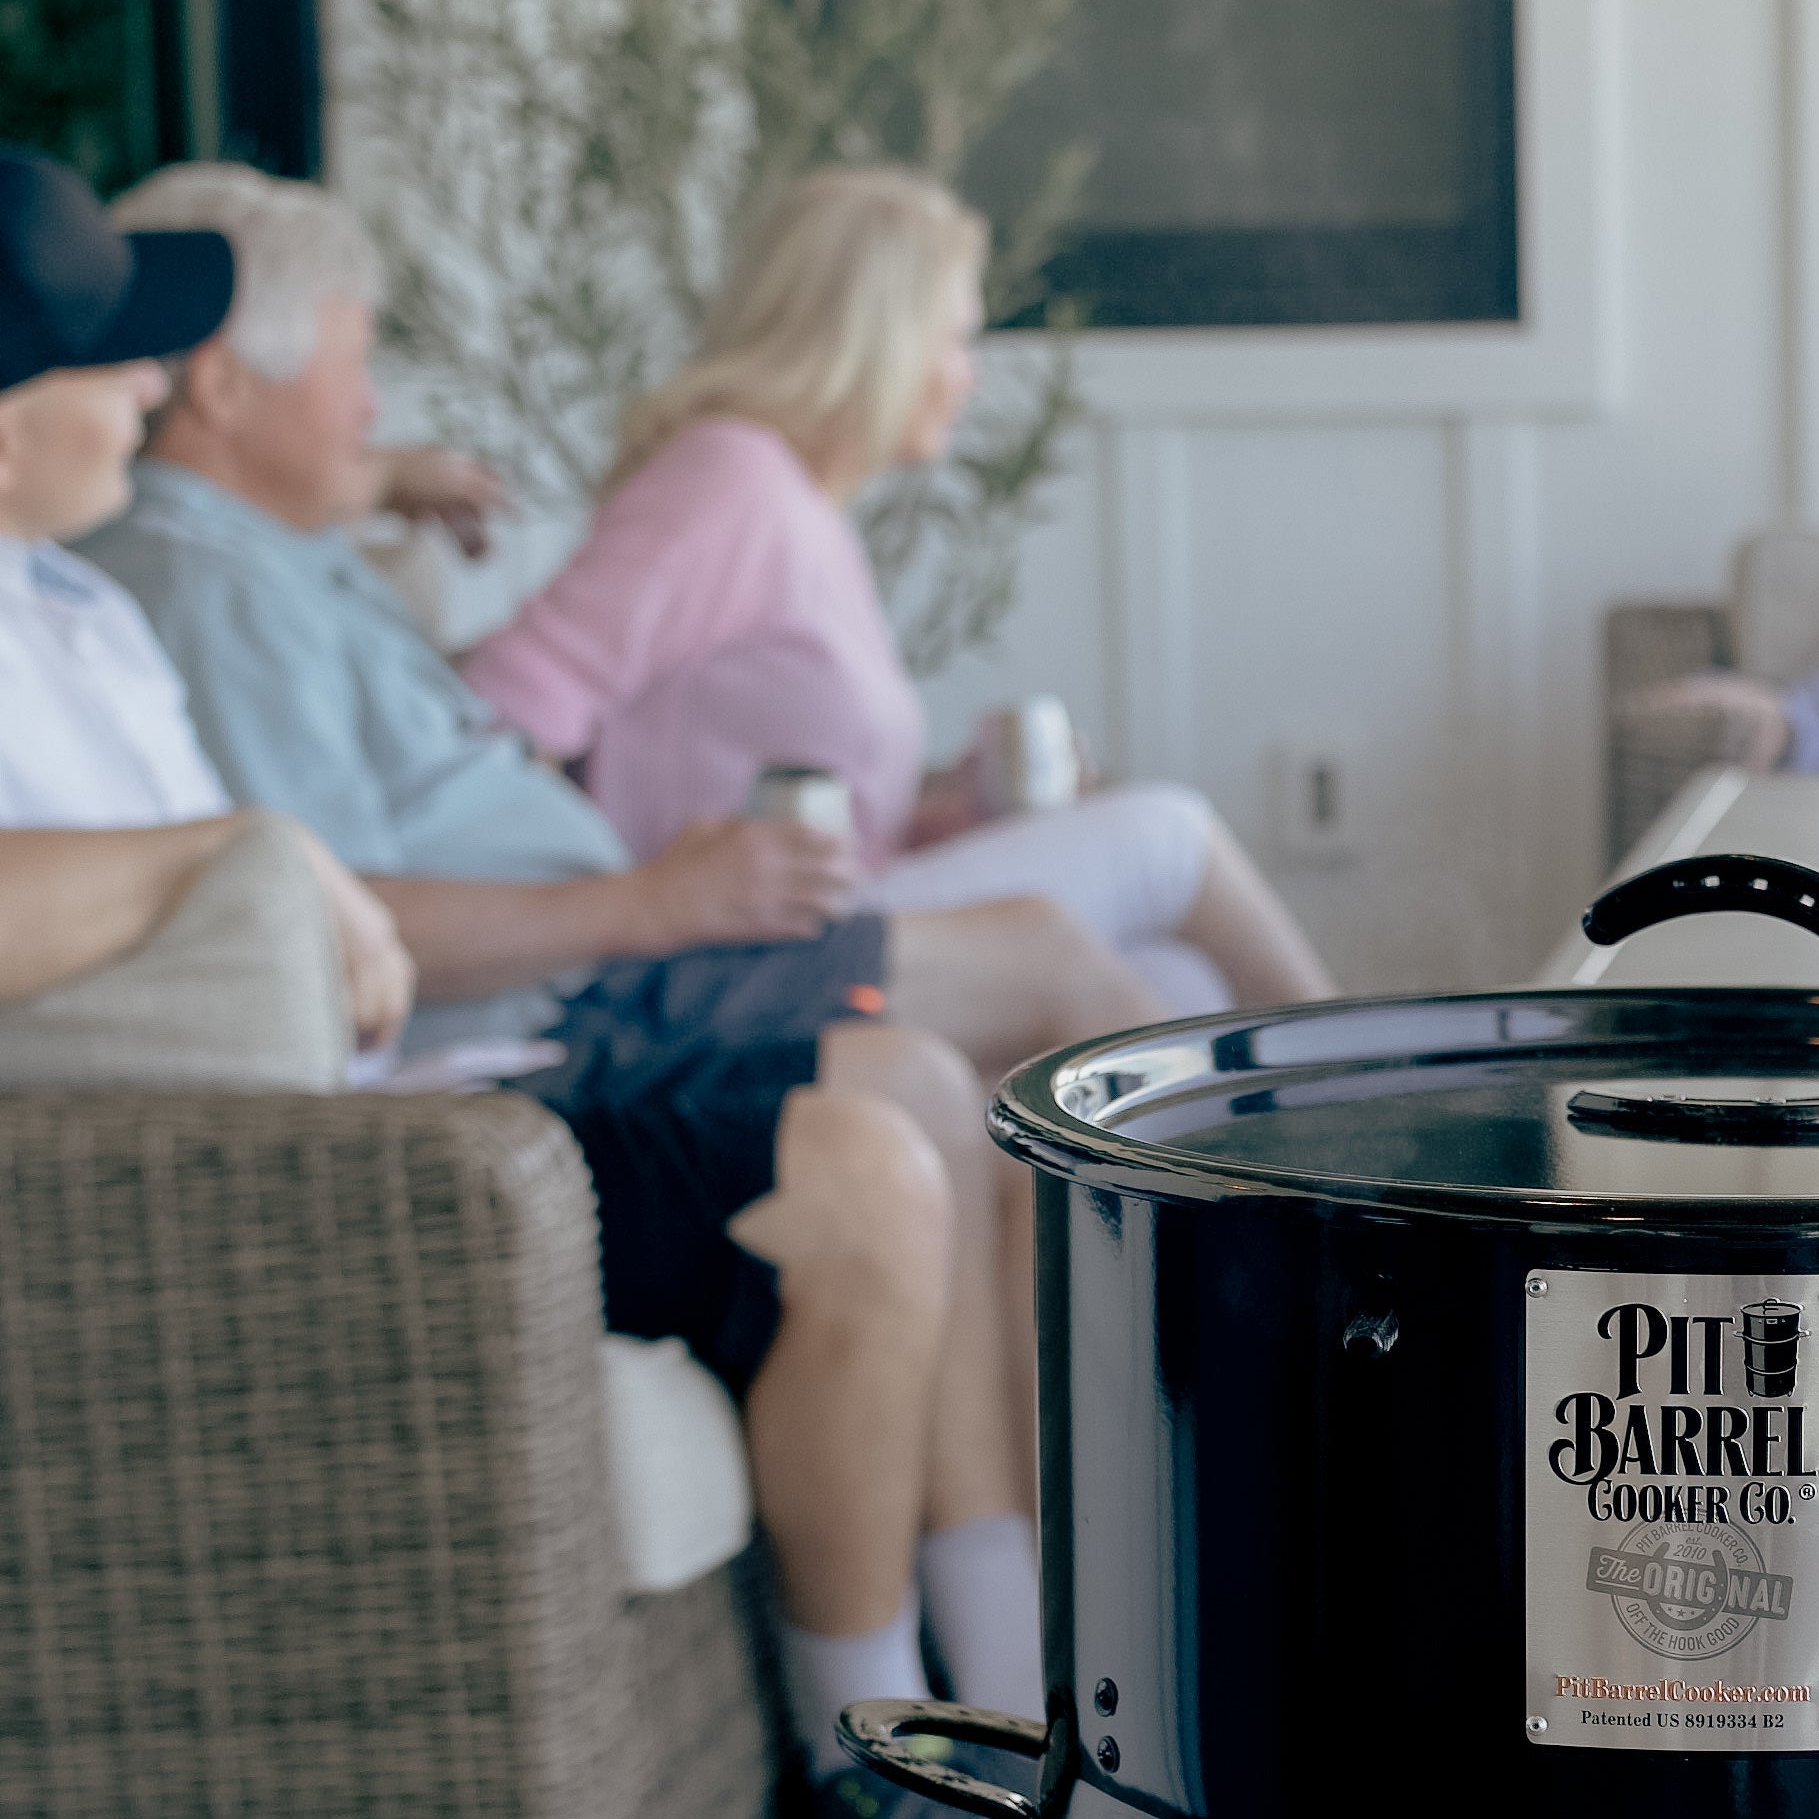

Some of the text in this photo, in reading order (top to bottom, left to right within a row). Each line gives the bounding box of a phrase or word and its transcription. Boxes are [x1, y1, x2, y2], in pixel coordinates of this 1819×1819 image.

[1597, 1303, 1735, 1400] PIT
[1548, 1392, 1819, 1485] BARREL
[1588, 1479, 1731, 1524] COOKER
[1635, 1522, 1749, 1567] PIT BARREL COOKER CO.
[1673, 1544, 1707, 1561] 2010
[1596, 1554, 1642, 1583] The
[1626, 1602, 1741, 1652] OFF THE HOOK GOOD
[1555, 1674, 1812, 1704] PitBarrelCooker.com
[1581, 1710, 1785, 1729] Patented US 8919334 B2
